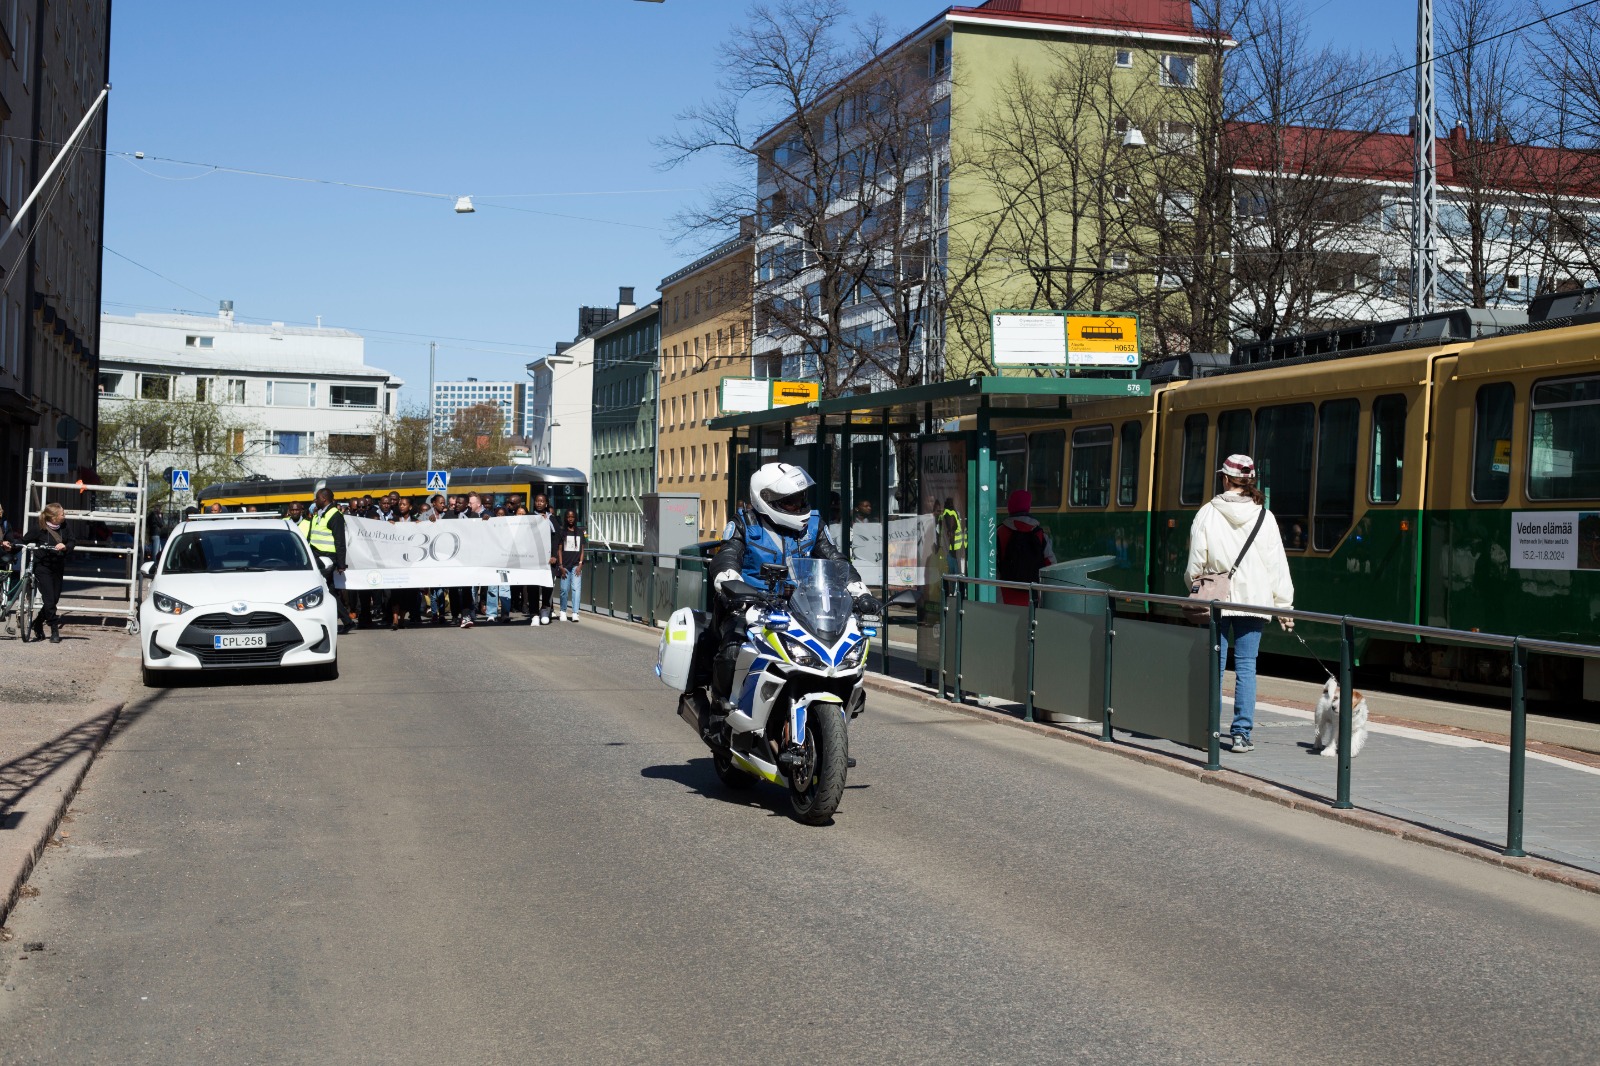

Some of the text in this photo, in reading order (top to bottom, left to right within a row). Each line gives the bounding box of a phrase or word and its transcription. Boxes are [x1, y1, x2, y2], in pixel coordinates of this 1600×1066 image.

[996, 317, 1001, 326] 3
[1114, 344, 1135, 352] H0632
[565, 485, 571, 494] 3
[1517, 522, 1572, 535] Veden elämää
[357, 528, 461, 563] Kwibuka 30
[222, 636, 264, 646] CPL-258
